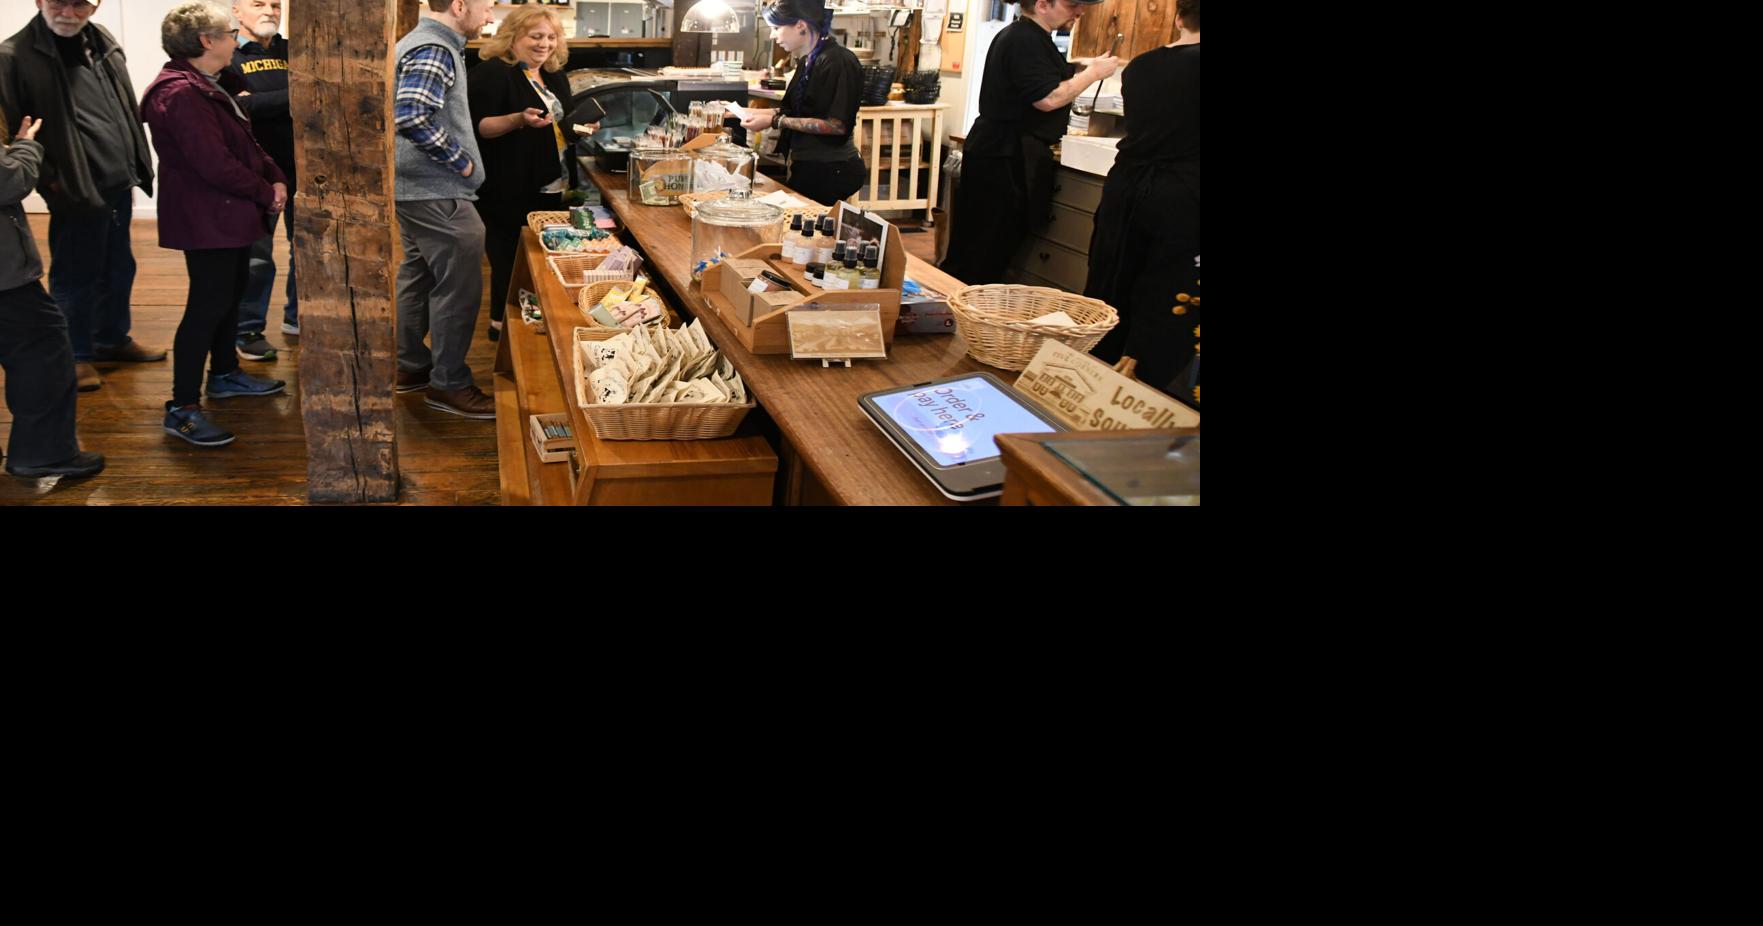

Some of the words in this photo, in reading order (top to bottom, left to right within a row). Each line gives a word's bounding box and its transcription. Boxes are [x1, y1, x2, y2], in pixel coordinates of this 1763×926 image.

[241, 59, 288, 74] MICHIGA
[934, 388, 972, 411] Order
[930, 407, 964, 429] here
